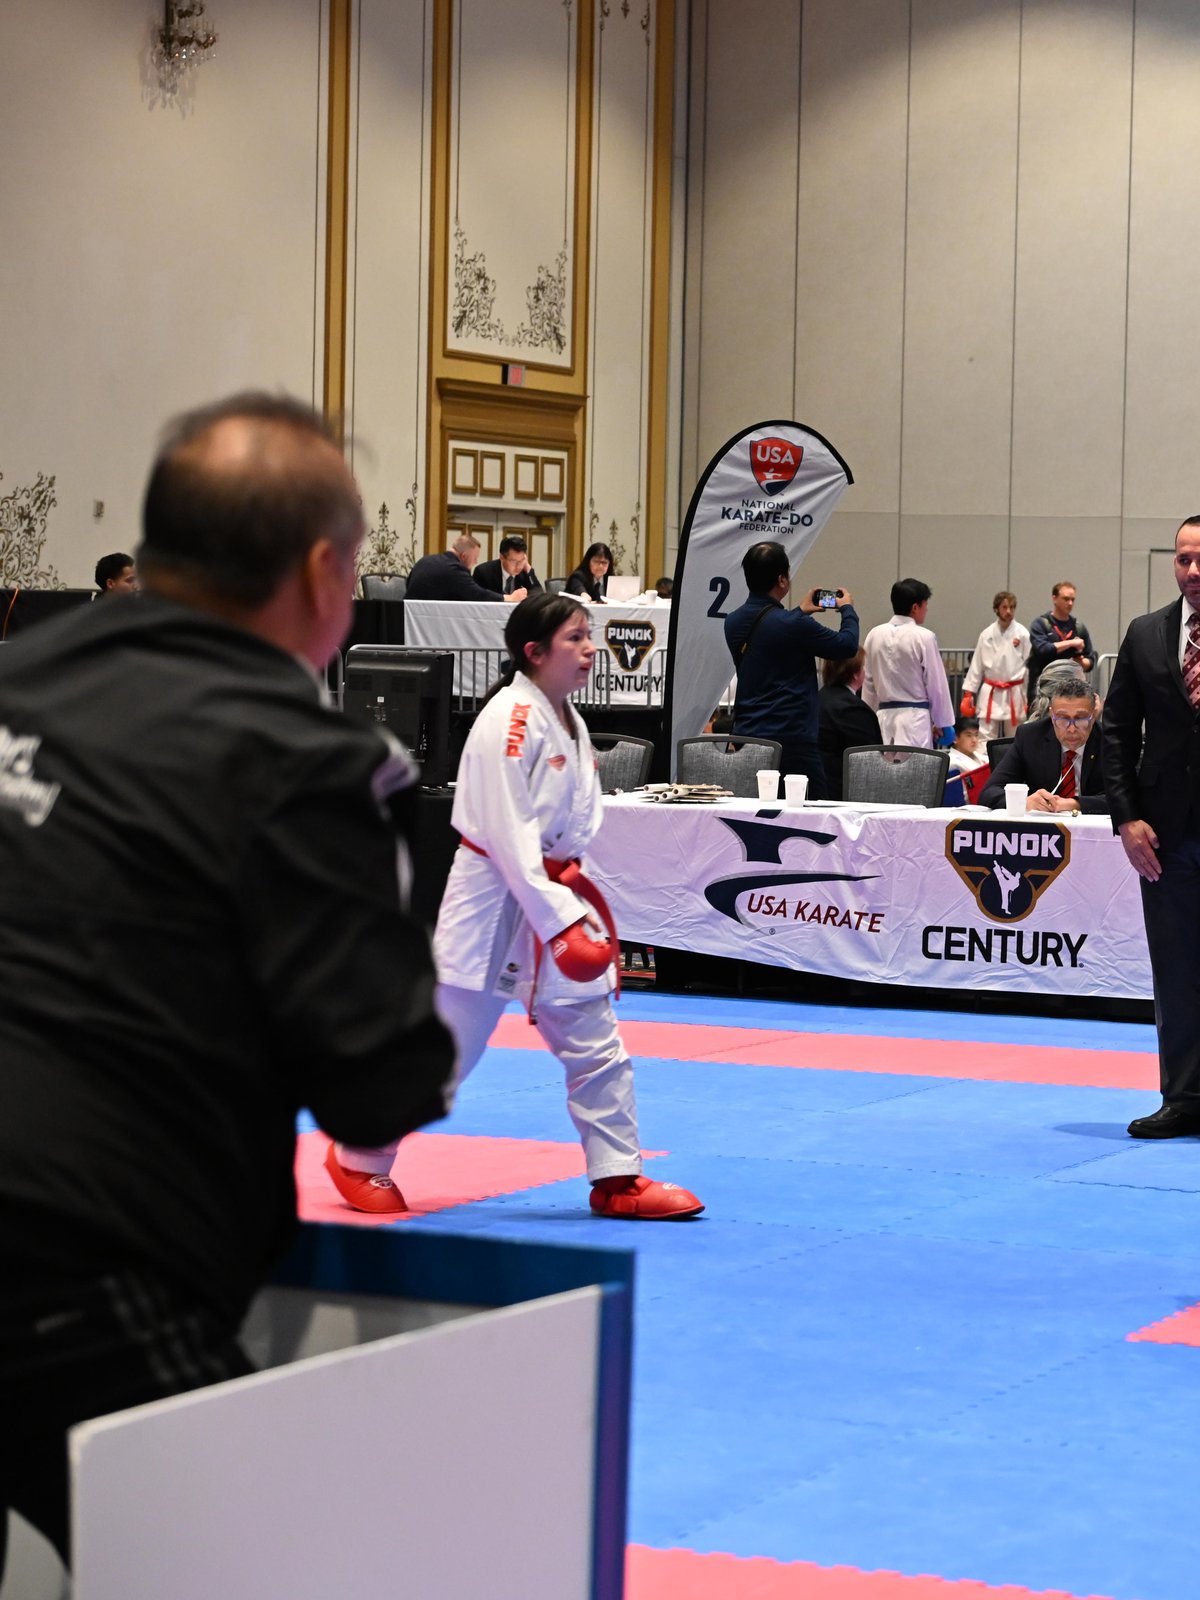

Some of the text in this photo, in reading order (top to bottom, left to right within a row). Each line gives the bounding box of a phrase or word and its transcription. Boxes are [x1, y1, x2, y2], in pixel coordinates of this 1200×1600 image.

[757, 446, 794, 465] USA
[721, 507, 814, 527] KARATE-DO
[741, 499, 796, 511] NATIONAL
[739, 523, 794, 535] FEDERATION
[707, 576, 730, 619] 2
[608, 627, 652, 641] PUNOK
[505, 703, 532, 758] PUNOK
[953, 830, 1062, 859] PUNOK
[748, 893, 885, 933] USA KARATE
[922, 925, 1088, 968] CENTURY
